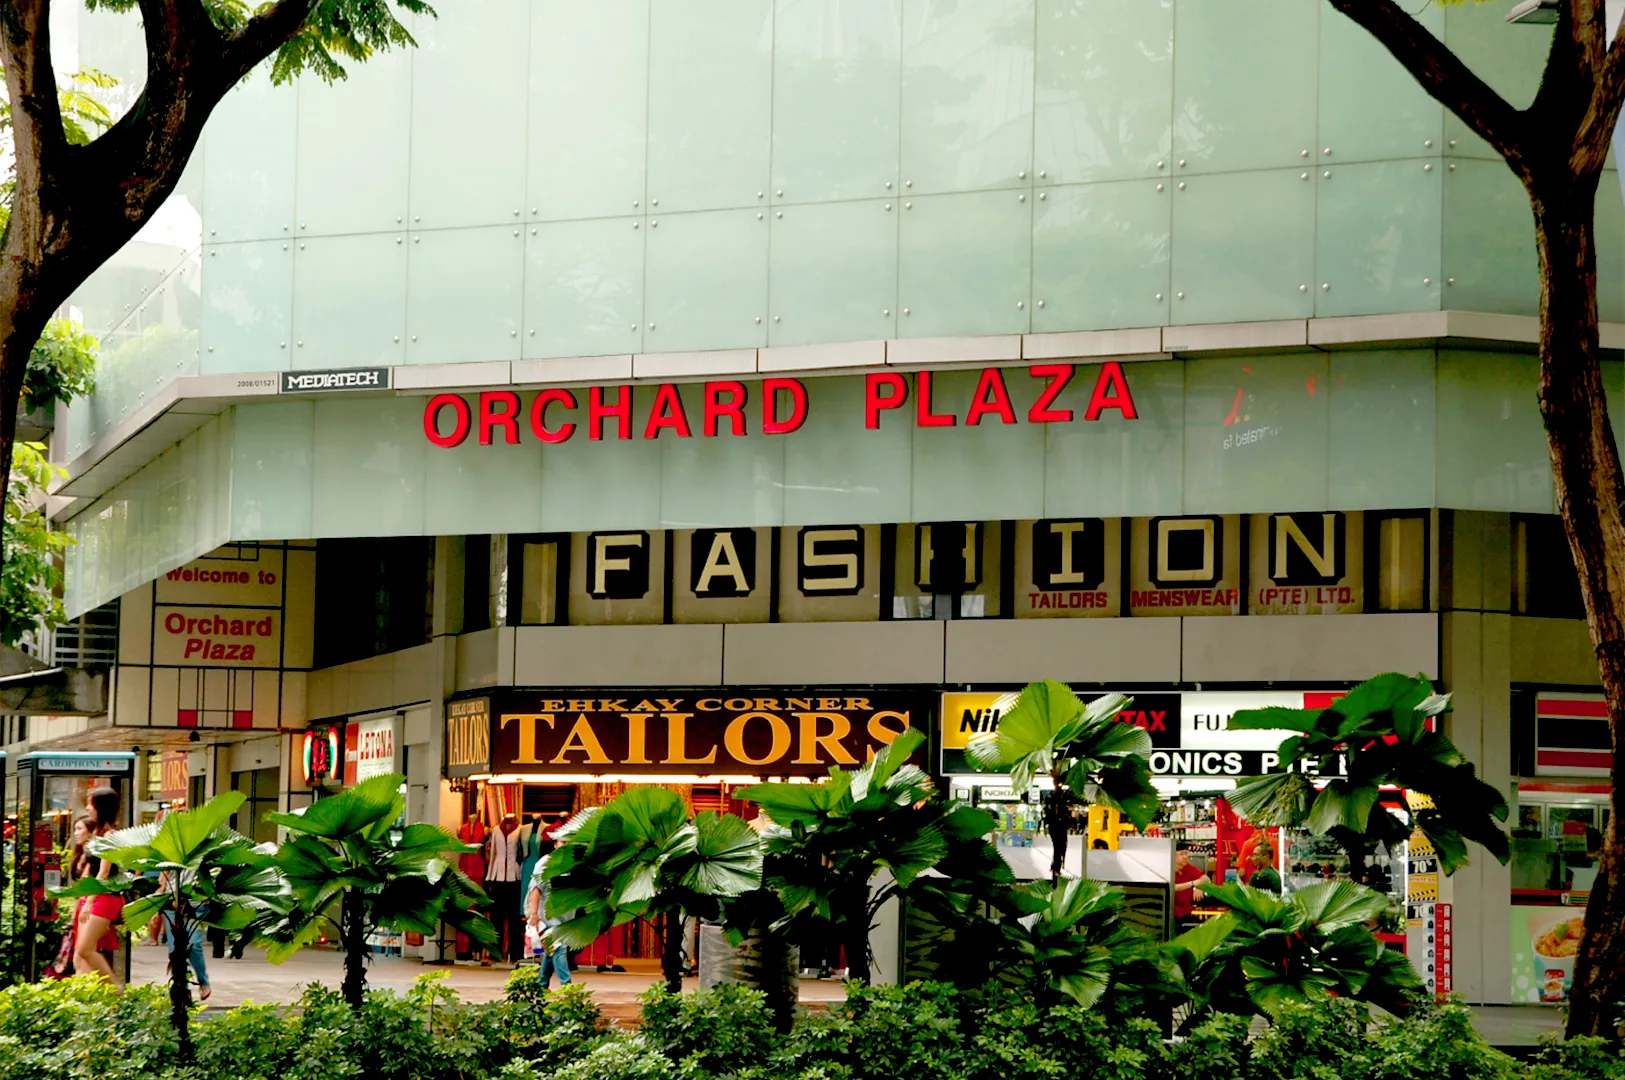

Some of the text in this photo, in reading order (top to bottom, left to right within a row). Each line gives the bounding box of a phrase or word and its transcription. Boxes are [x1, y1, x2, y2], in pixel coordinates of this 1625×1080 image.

[287, 371, 379, 389] MEDIATECH
[423, 361, 1139, 448] ORCHARD PLAZA
[593, 513, 1335, 594] FASHION
[166, 566, 277, 585] Welcome to
[1028, 586, 1356, 609] TAILORS MENSWEAR (PTE) LTD.
[165, 613, 272, 661] Orchard Plaza
[541, 696, 875, 713] EHKAY CORNER
[1110, 710, 1167, 732] TAX
[448, 713, 490, 767] TAILORS
[500, 710, 912, 766] TAILORS
[1149, 752, 1243, 775] ONICS
[984, 789, 1019, 797] NOKIA
